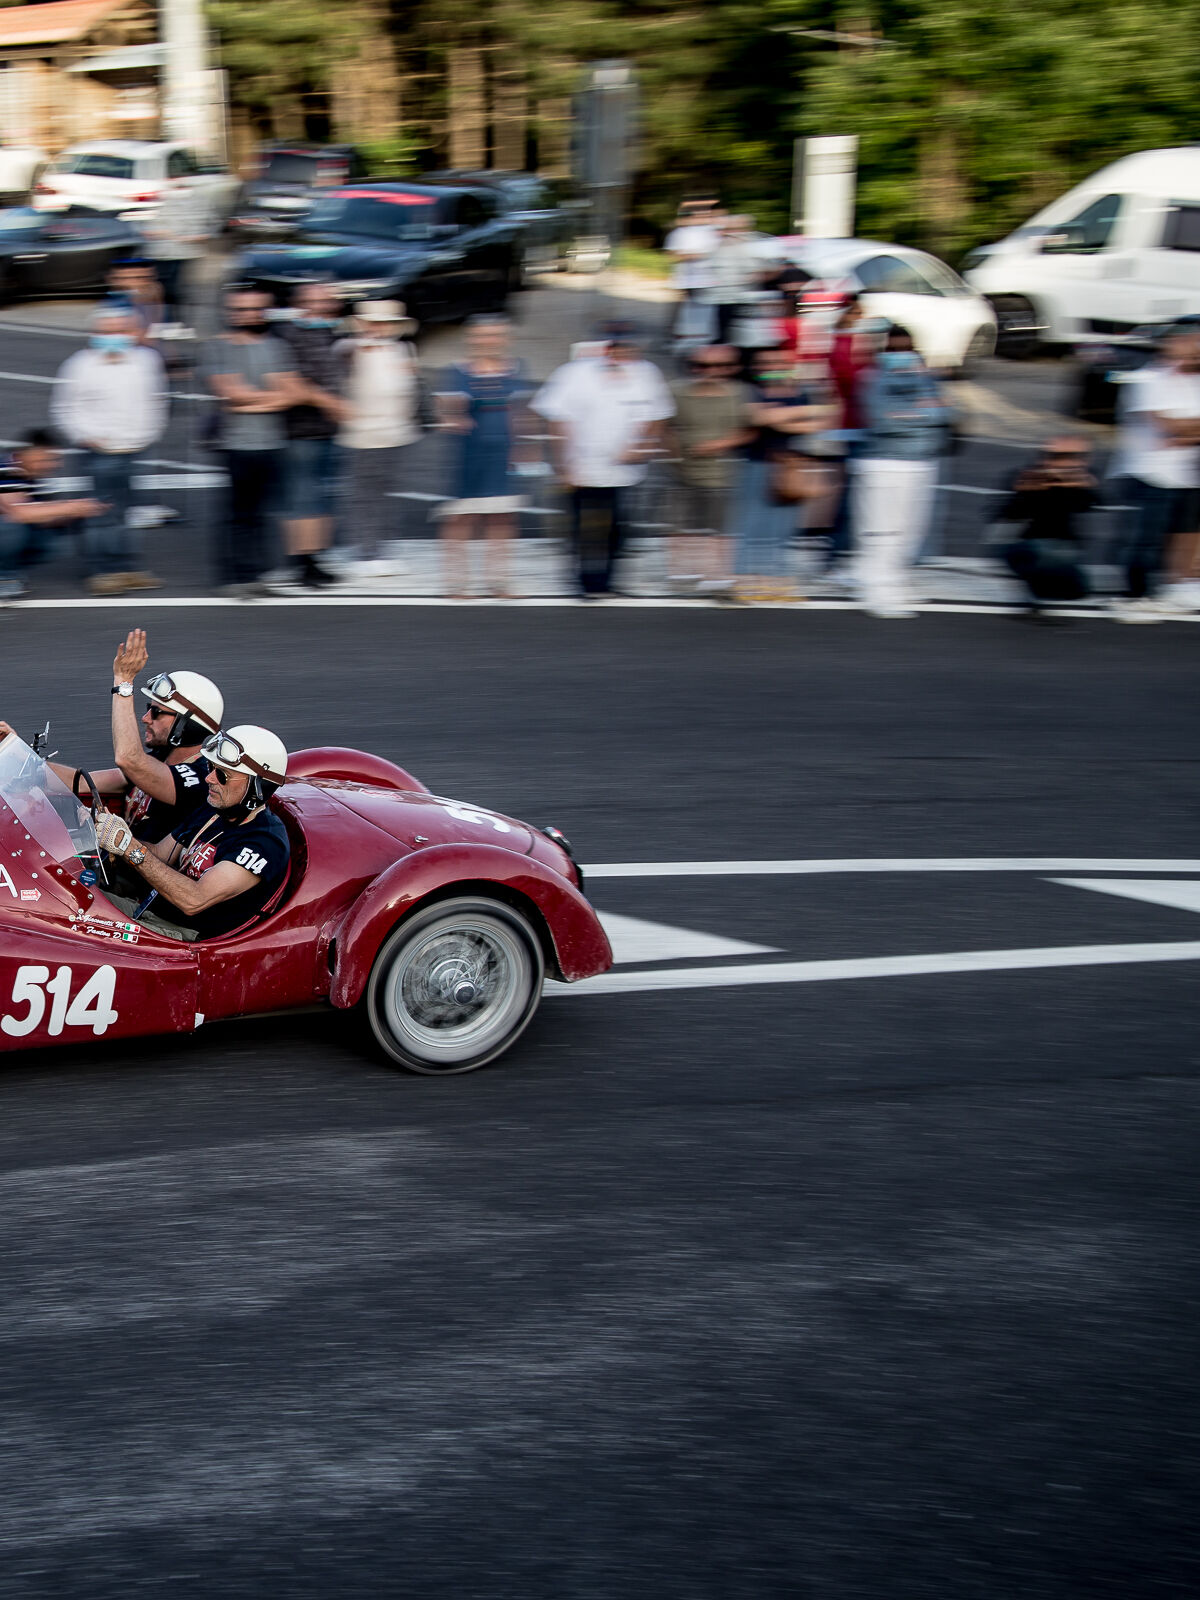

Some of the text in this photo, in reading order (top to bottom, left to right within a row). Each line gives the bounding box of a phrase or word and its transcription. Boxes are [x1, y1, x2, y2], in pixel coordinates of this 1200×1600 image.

[174, 764, 200, 788] 514
[235, 846, 268, 875] 514
[0, 964, 118, 1037] 514
